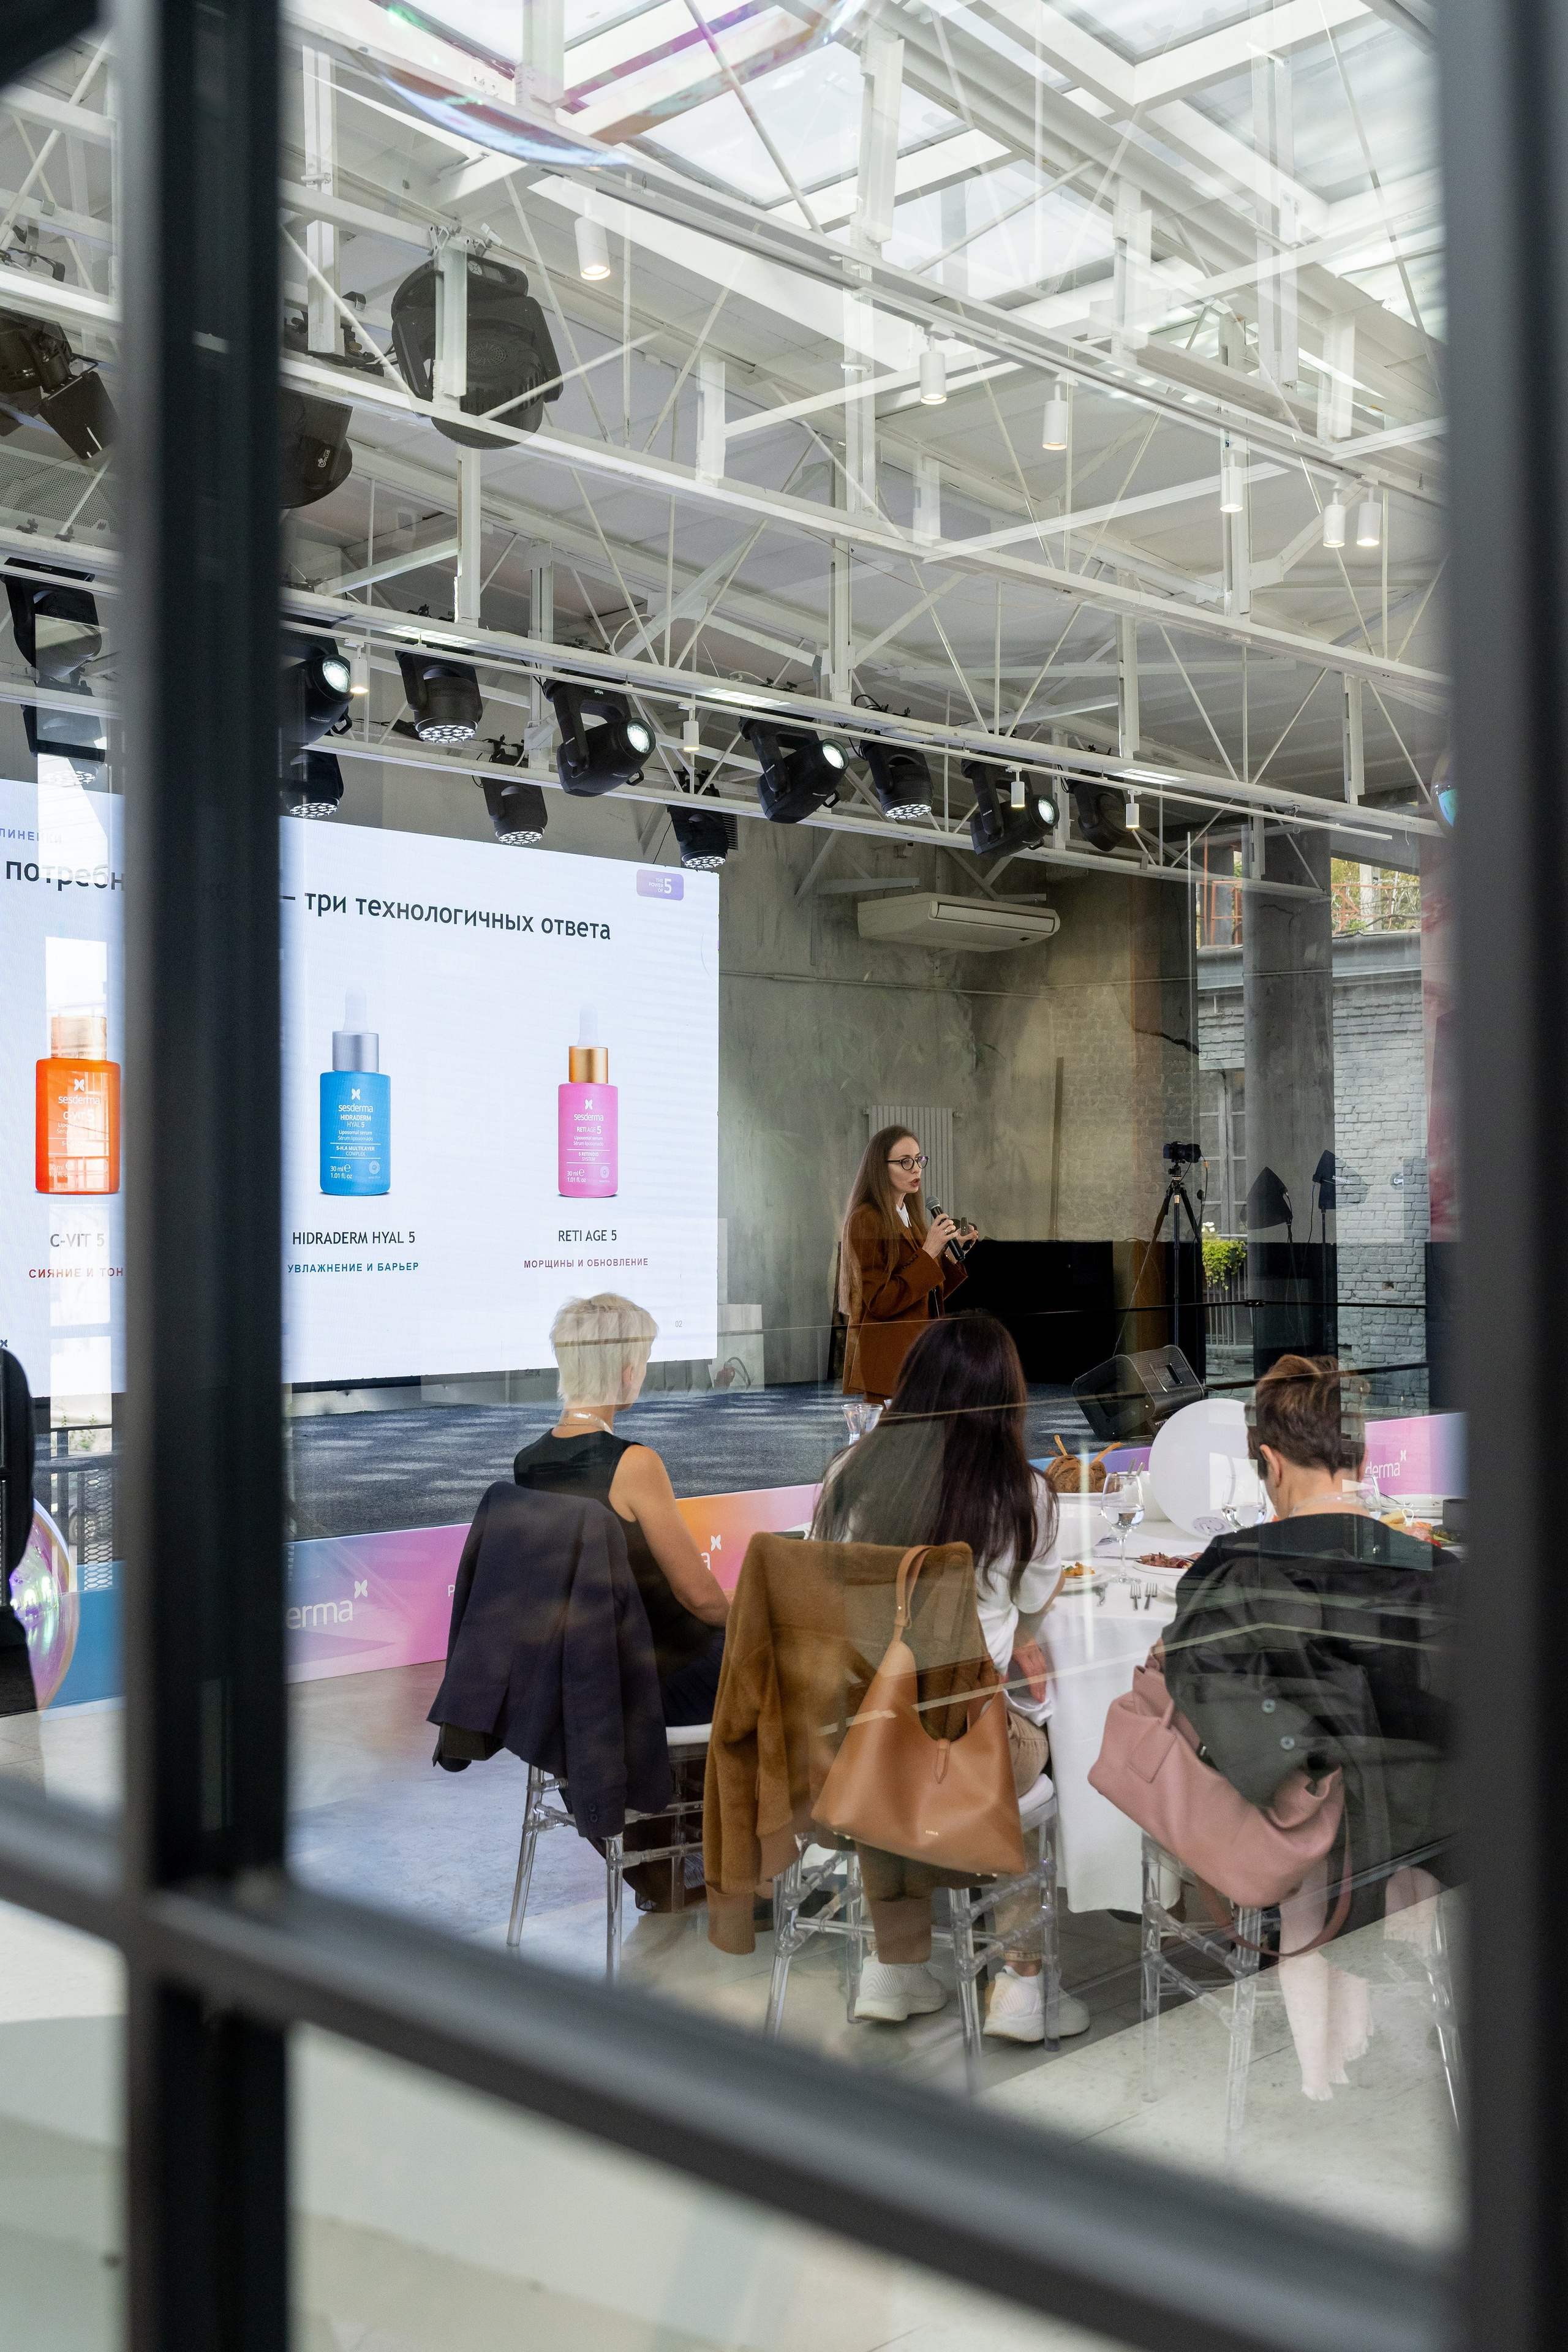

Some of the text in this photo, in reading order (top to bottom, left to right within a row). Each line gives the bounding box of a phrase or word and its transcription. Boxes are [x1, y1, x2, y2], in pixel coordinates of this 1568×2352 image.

[664, 878, 672, 894] 5
[304, 892, 346, 917] три
[355, 898, 534, 933] технологичных
[541, 918, 611, 940] ответа
[58, 1095, 100, 1105] sesderma
[338, 1103, 374, 1112] sesderma
[63, 1109, 95, 1122] C-VIT 5
[574, 1113, 604, 1121] sesderma
[597, 1126, 601, 1134] 5
[50, 1233, 105, 1247] C-VIT 5
[292, 1231, 415, 1245] HIDRADERM HYAL 5
[558, 1230, 617, 1242] RETI AGE 5
[287, 1262, 419, 1273] УВЛАЖНЕНИЕ И БАРЬЕР
[524, 1259, 574, 1268] МОРЩИНЫ
[587, 1258, 648, 1267] ОБНОВЛЕНИЕ
[29, 1268, 81, 1278] СИЯНИЕ
[86, 1268, 94, 1278] И
